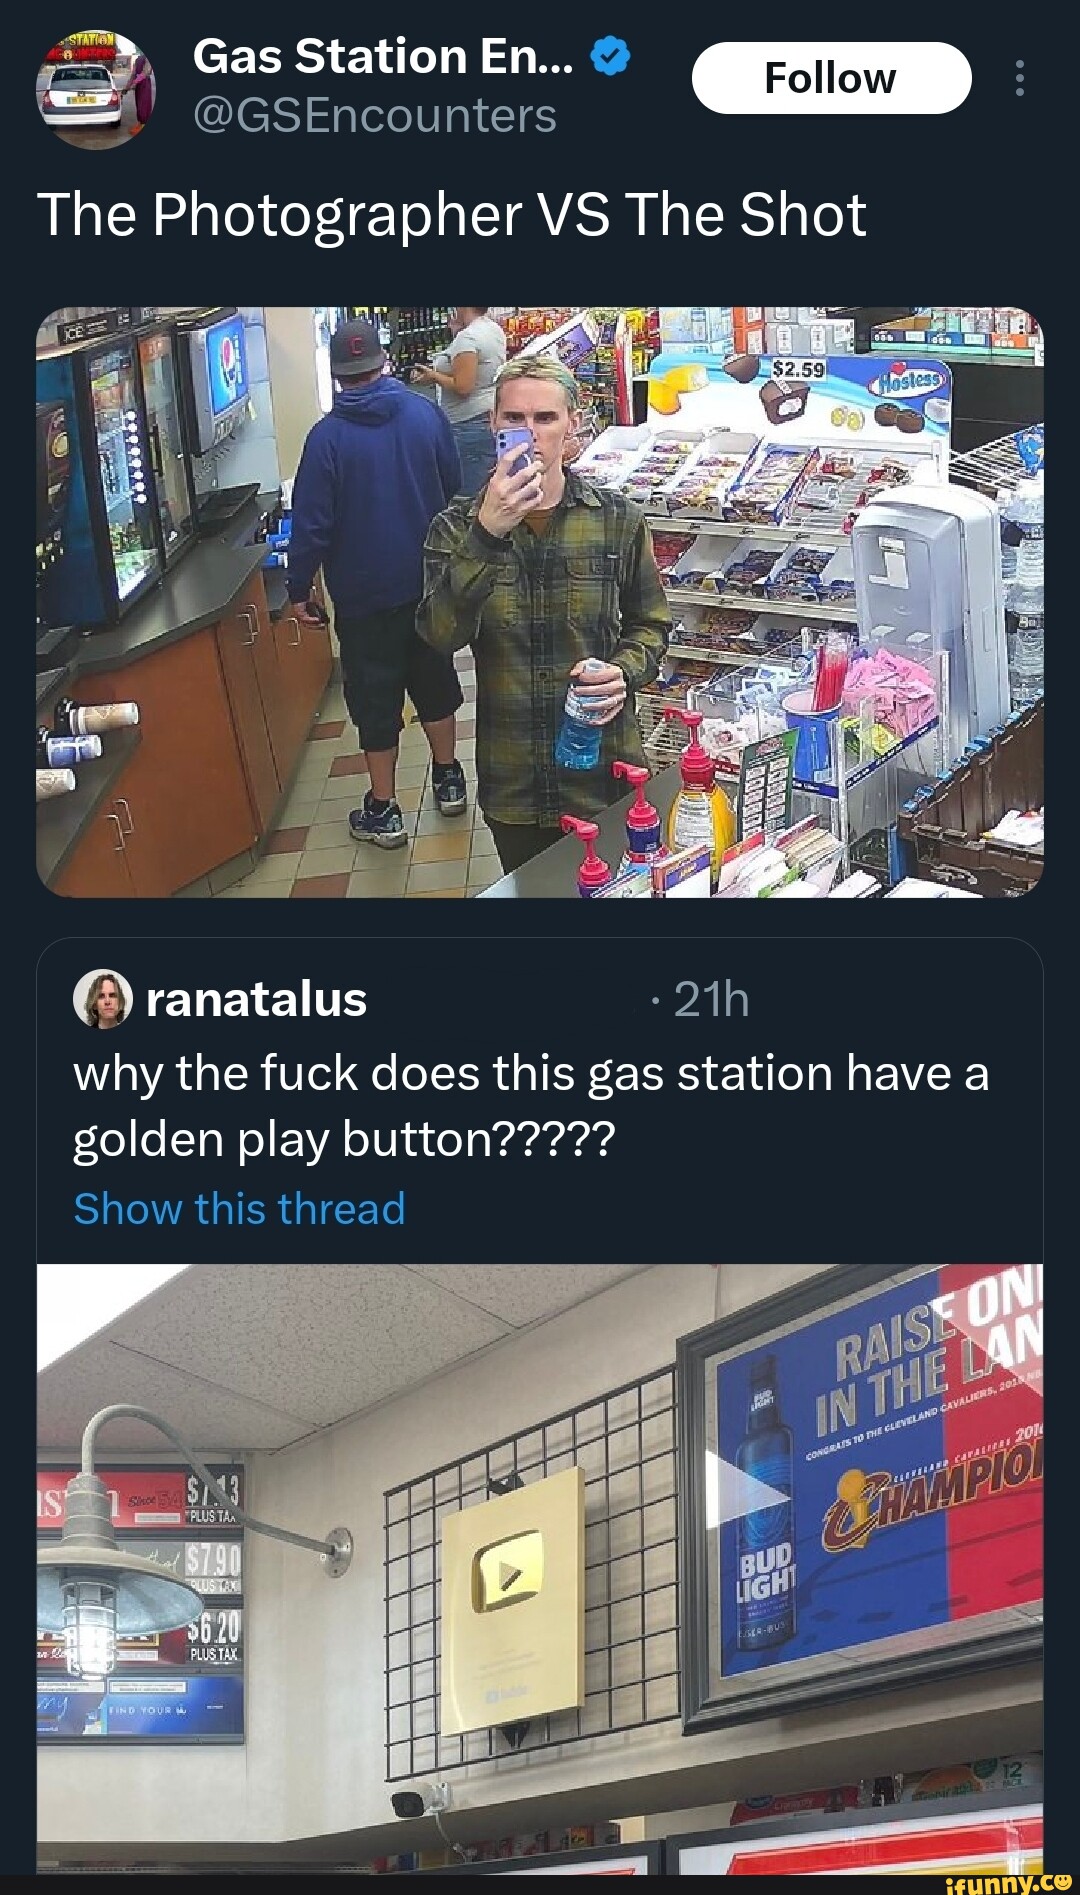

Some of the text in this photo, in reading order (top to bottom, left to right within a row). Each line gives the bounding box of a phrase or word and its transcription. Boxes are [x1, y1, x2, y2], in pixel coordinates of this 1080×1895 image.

[773, 360, 824, 378] $2.59
[878, 371, 941, 394] Hostess
[836, 1264, 1043, 1381] RAISE ON
[816, 1382, 856, 1437] IN
[867, 1347, 948, 1417] THE
[806, 1438, 851, 1461] CONGRATS
[853, 1431, 864, 1443] TO
[866, 1425, 883, 1439] THE
[884, 1407, 938, 1432] CLEVELAND
[190, 1509, 215, 1523] PLUS
[188, 1543, 241, 1576] $7.90
[741, 1542, 792, 1579] BUD
[736, 1564, 796, 1604] LIGHT
[187, 1611, 239, 1643] $6.20
[190, 1647, 238, 1661] PLUS TAX
[109, 1706, 172, 1715] FIND YOUR
[1003, 1761, 1022, 1779] 12
